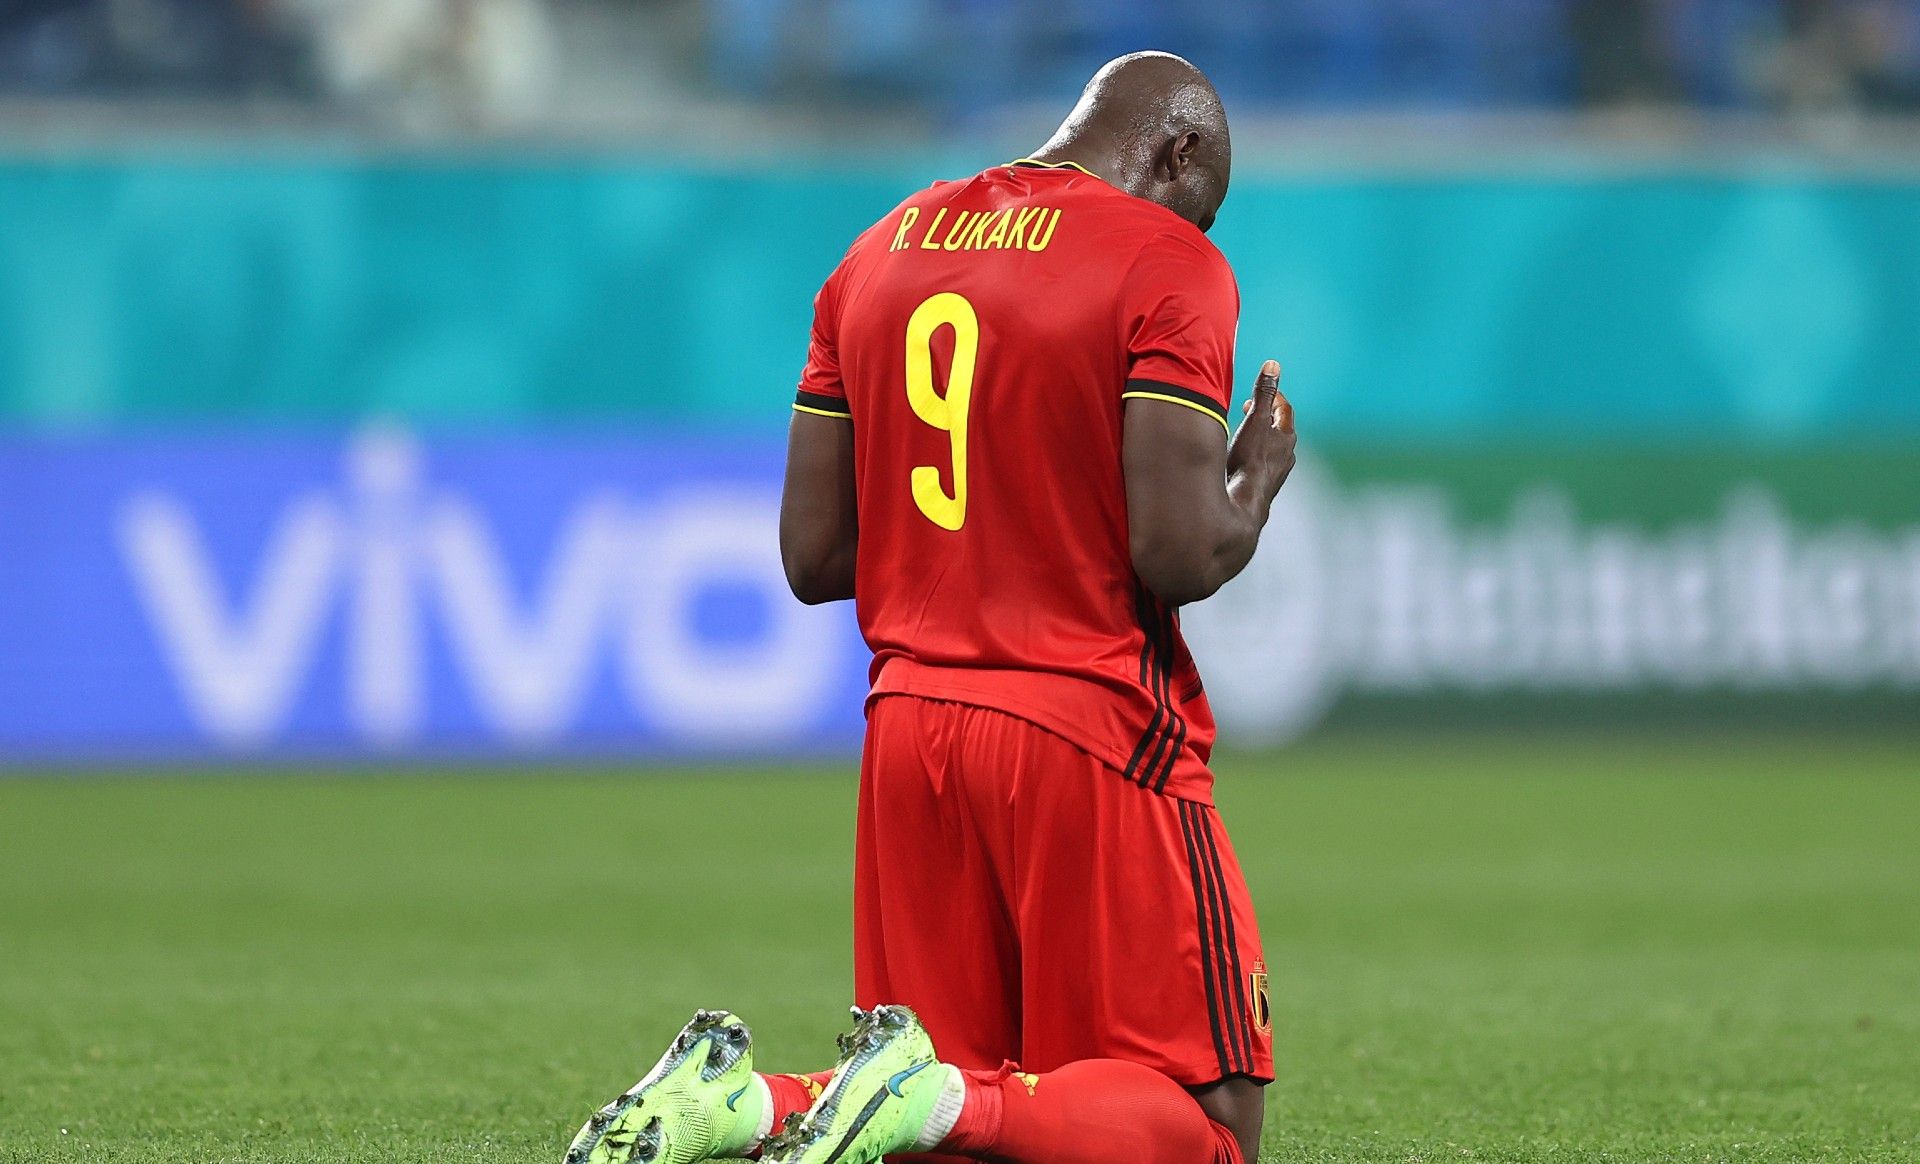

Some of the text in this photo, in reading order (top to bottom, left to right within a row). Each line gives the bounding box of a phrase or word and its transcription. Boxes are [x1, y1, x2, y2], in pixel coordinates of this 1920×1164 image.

[889, 207, 1062, 252] R. LUKAKU
[905, 291, 979, 531] 9
[120, 424, 848, 747] vivo
